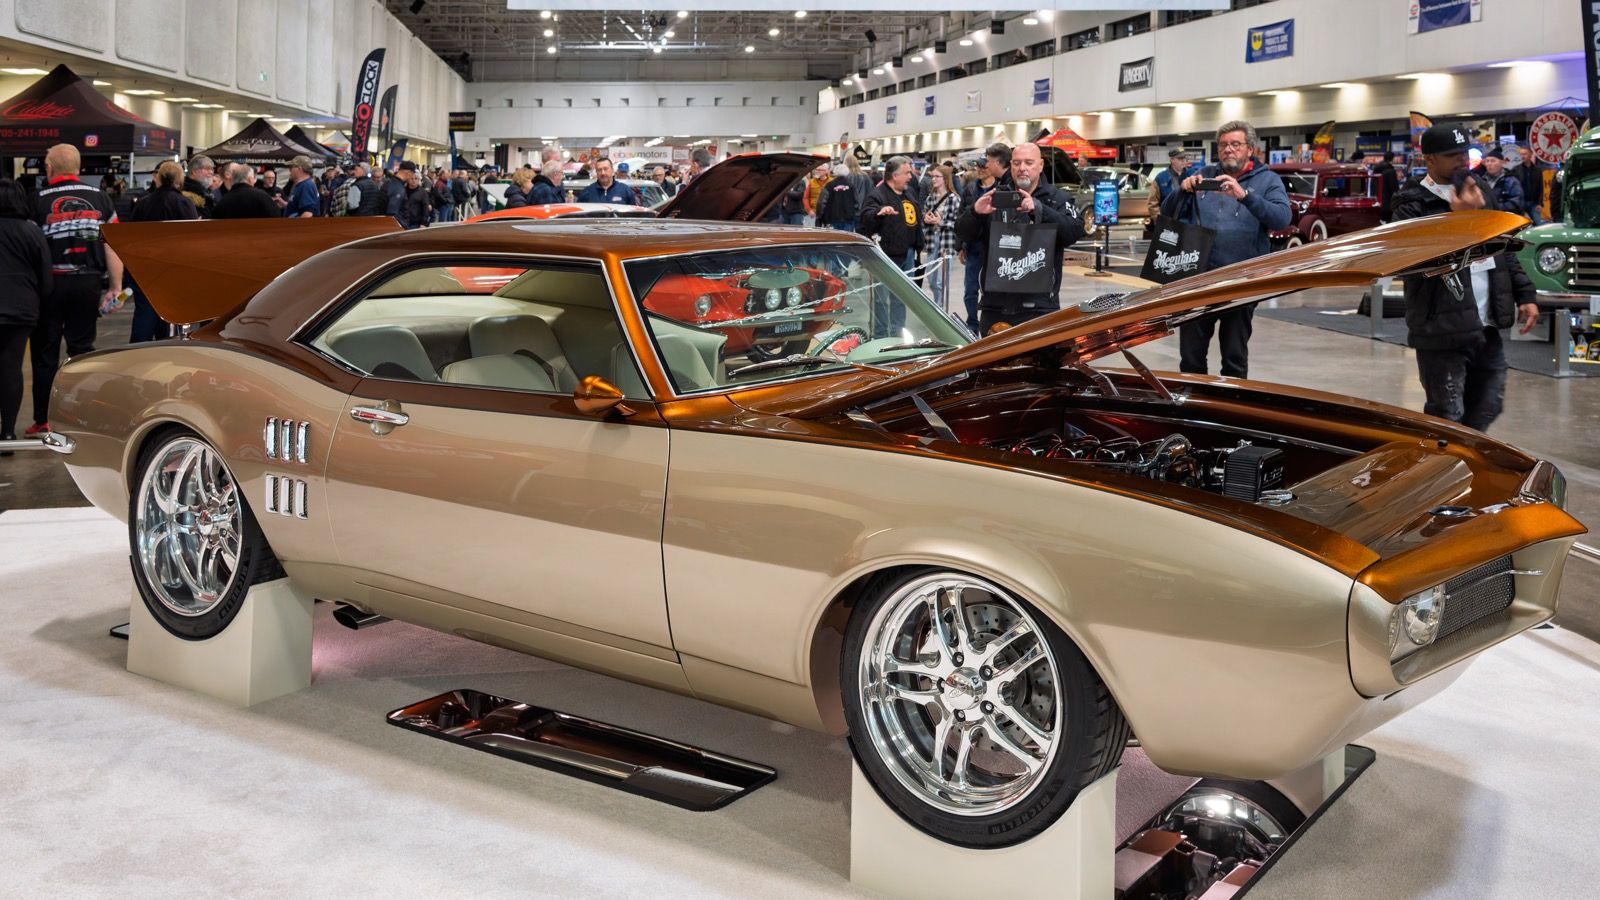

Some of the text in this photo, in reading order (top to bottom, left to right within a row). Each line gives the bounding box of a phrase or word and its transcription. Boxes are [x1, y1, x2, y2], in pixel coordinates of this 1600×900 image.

[362, 62, 378, 104] CLOCK
[1123, 60, 1153, 87] HAGERTY
[227, 138, 280, 146] VINTAGE
[637, 150, 668, 159] motors
[992, 794, 1051, 834] MICHELIN
